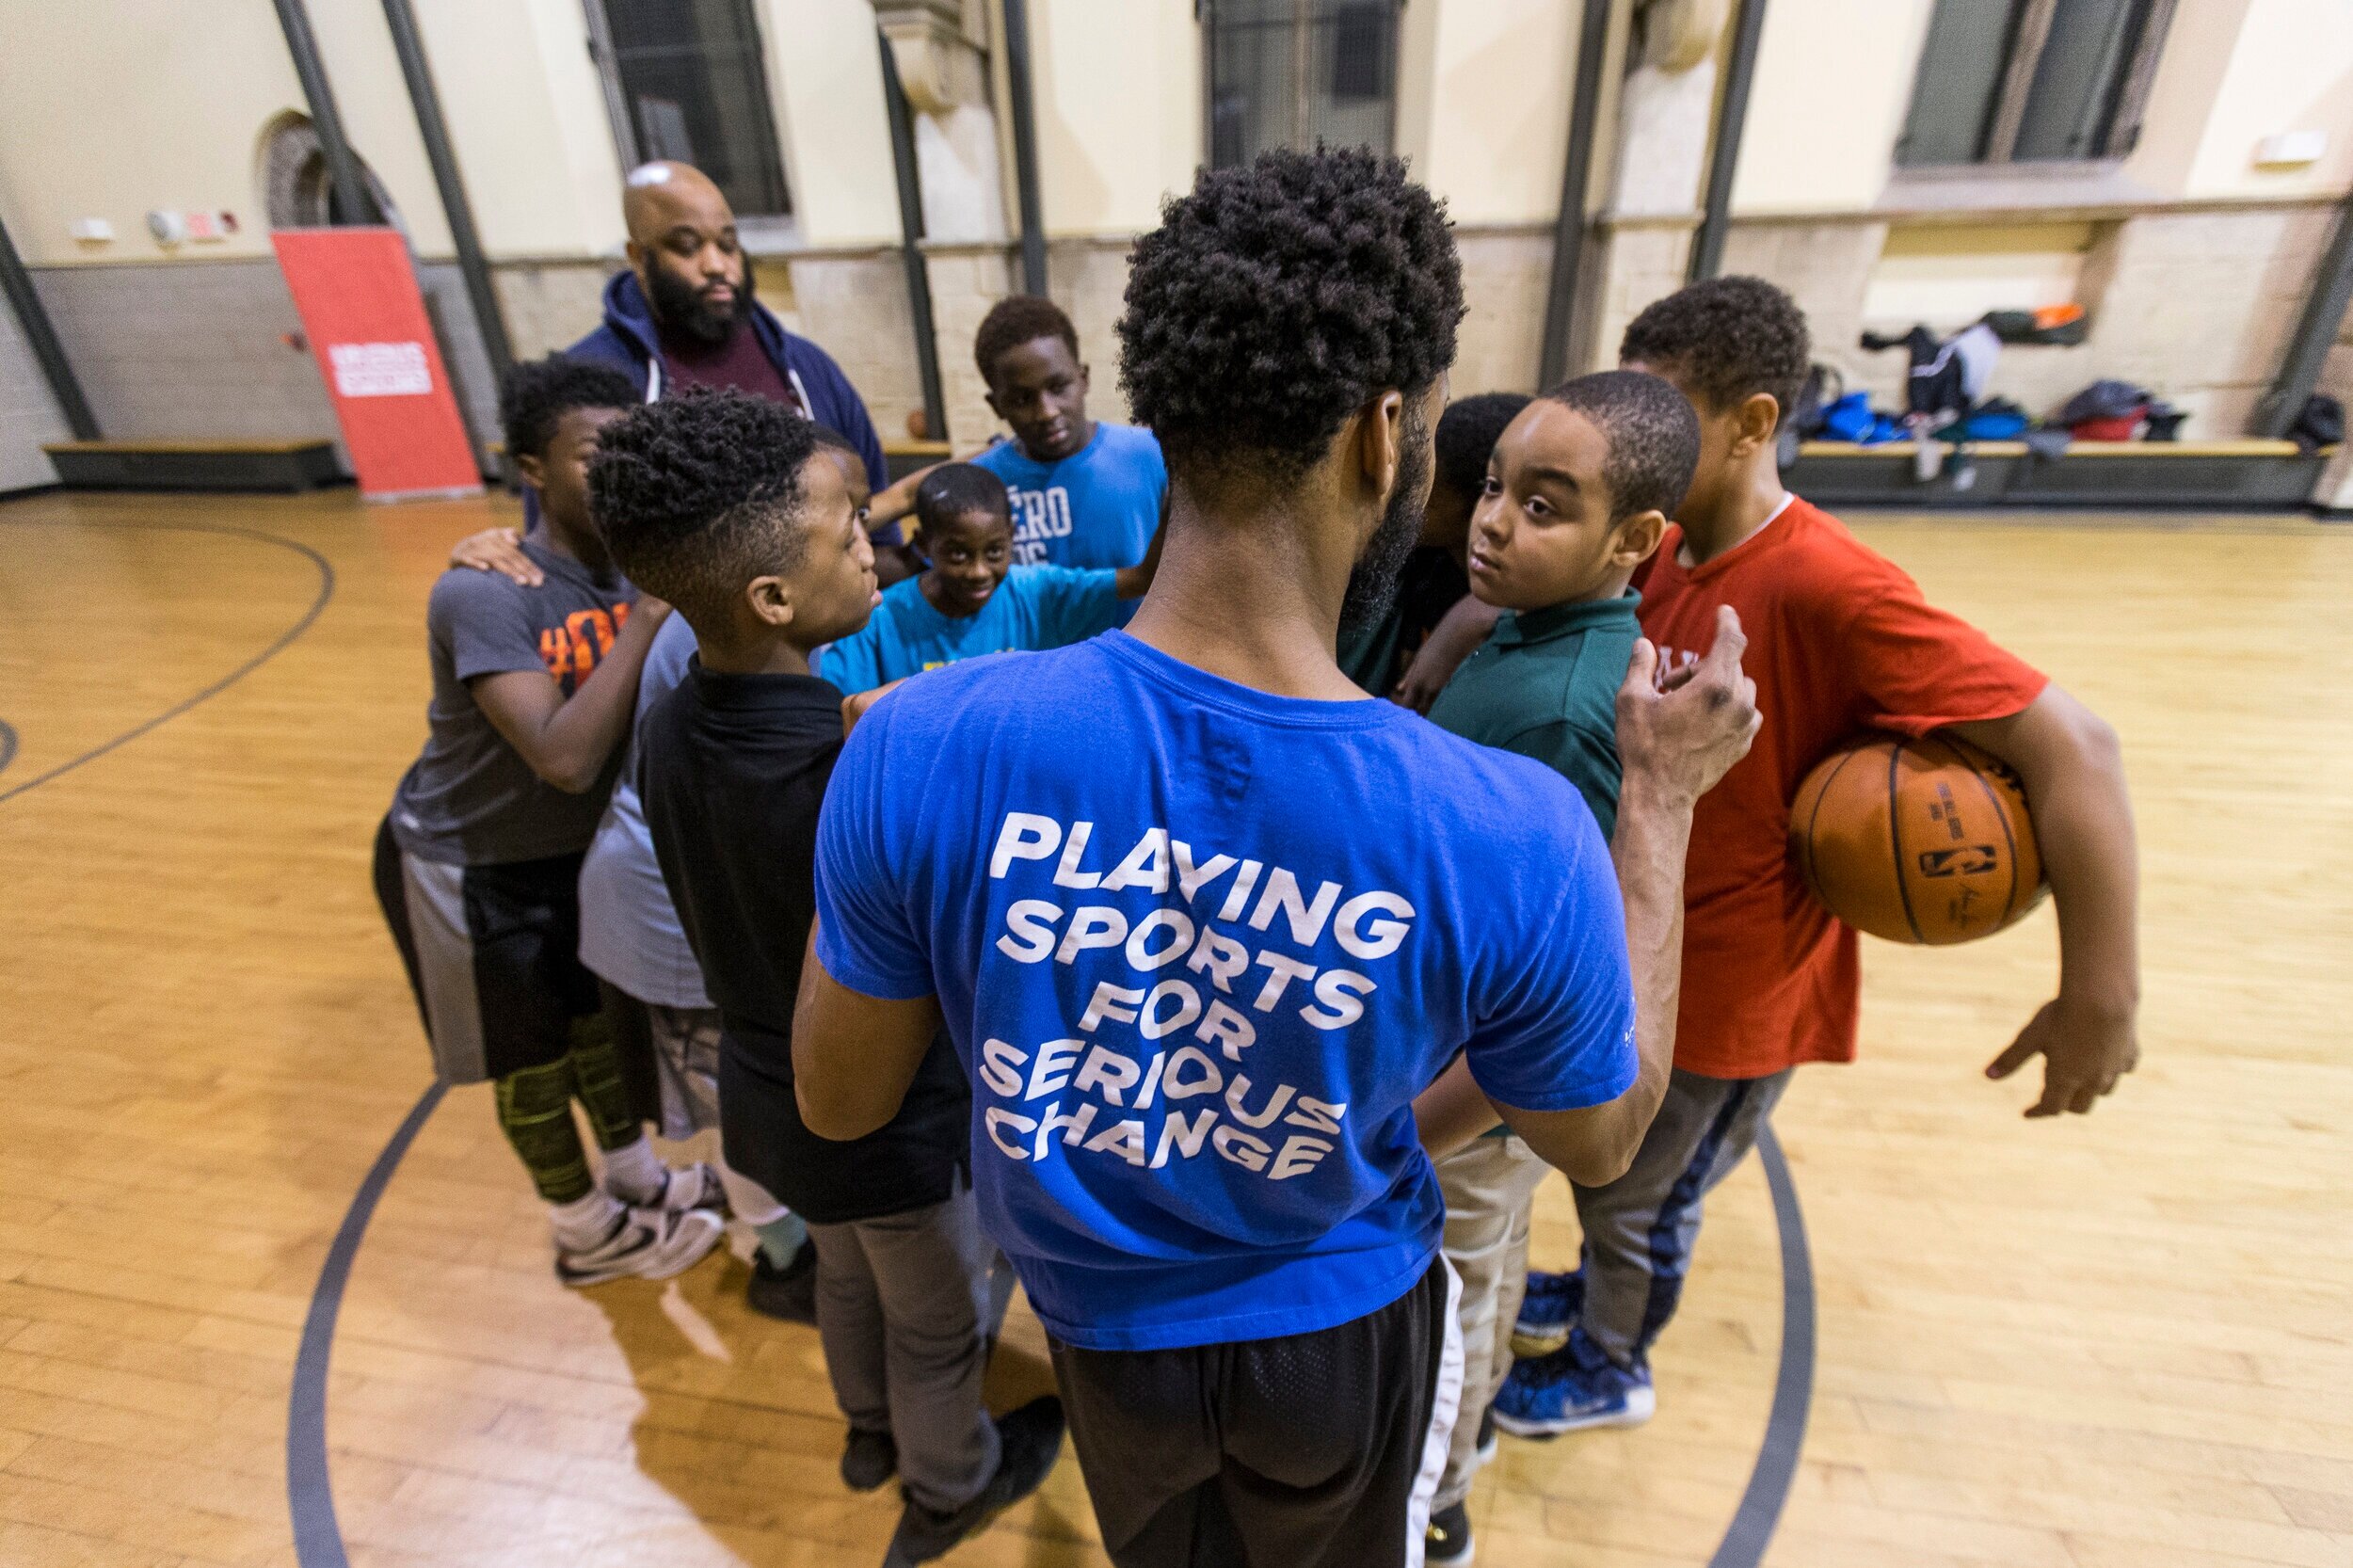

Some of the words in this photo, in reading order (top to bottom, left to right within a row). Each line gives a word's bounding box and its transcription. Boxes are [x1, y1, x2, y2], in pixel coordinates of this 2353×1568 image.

[989, 811, 1416, 960] PLAYING
[996, 899, 1378, 1031] SPORTS
[1078, 979, 1257, 1063] FOR
[979, 1038, 1347, 1135] SERIOUS
[984, 1100, 1334, 1180] CHANGE
